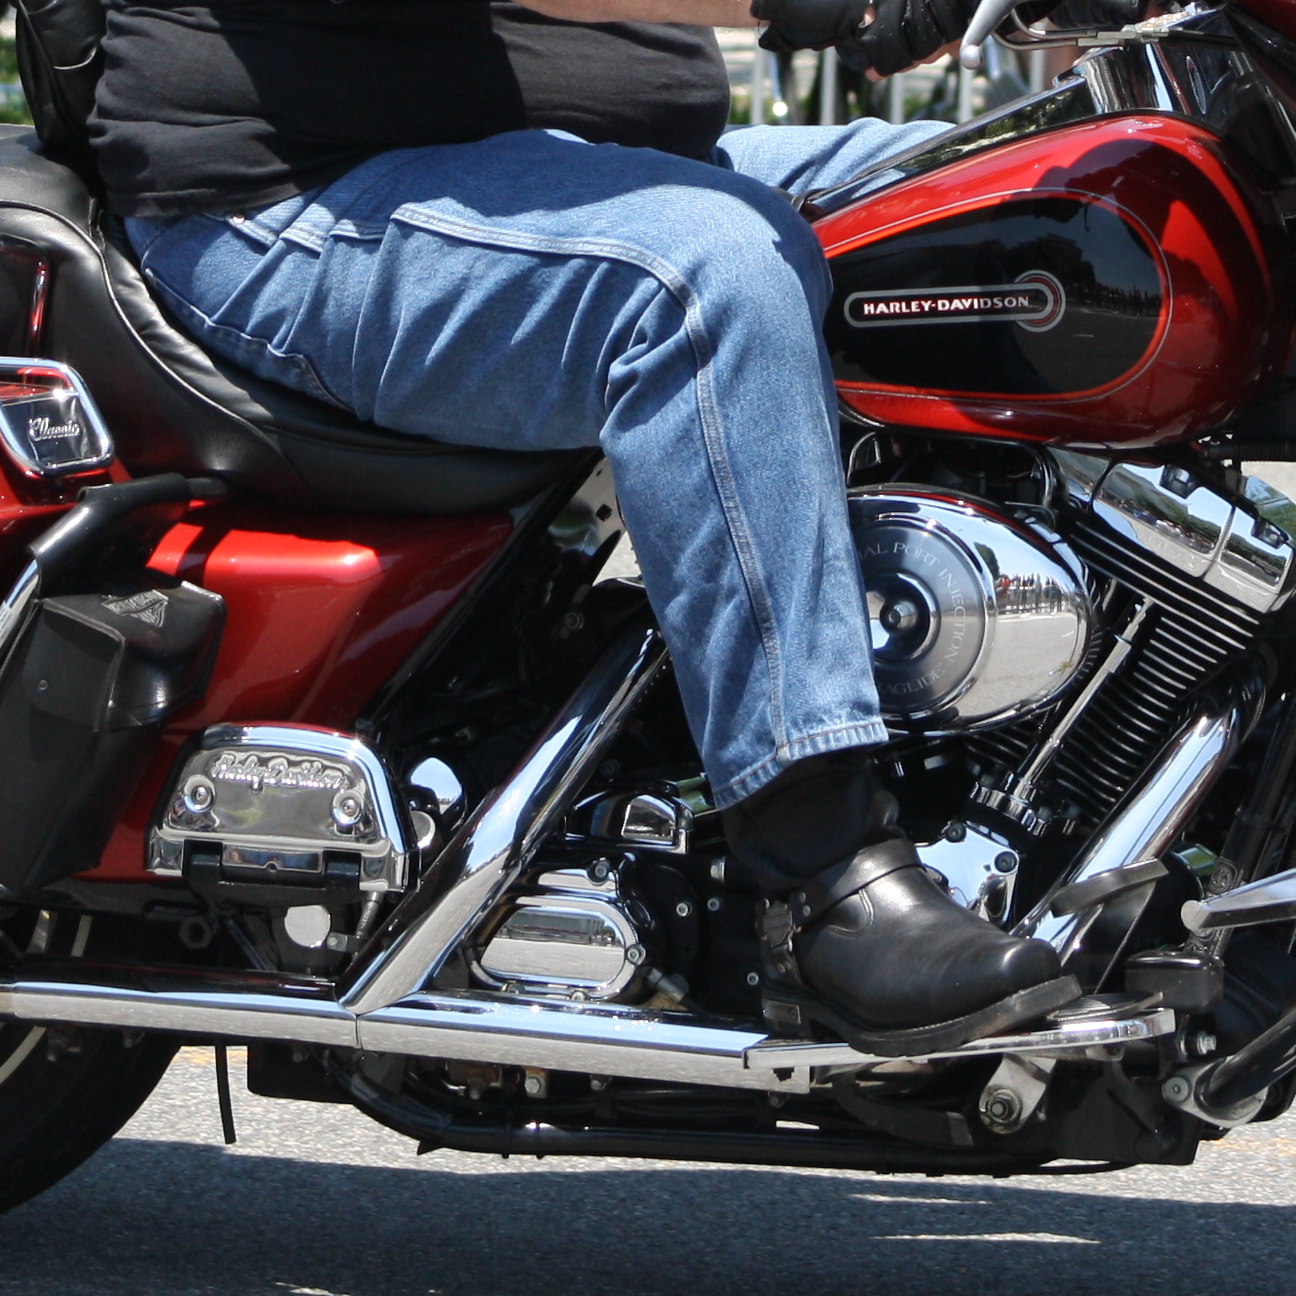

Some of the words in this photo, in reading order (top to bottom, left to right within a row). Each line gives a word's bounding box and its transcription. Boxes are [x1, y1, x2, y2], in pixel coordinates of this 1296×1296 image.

[863, 296, 1030, 315] HARLEY-DAVIDSON
[29, 417, 80, 442] Classic
[893, 541, 941, 567] PORT
[938, 567, 966, 663] INJECTION
